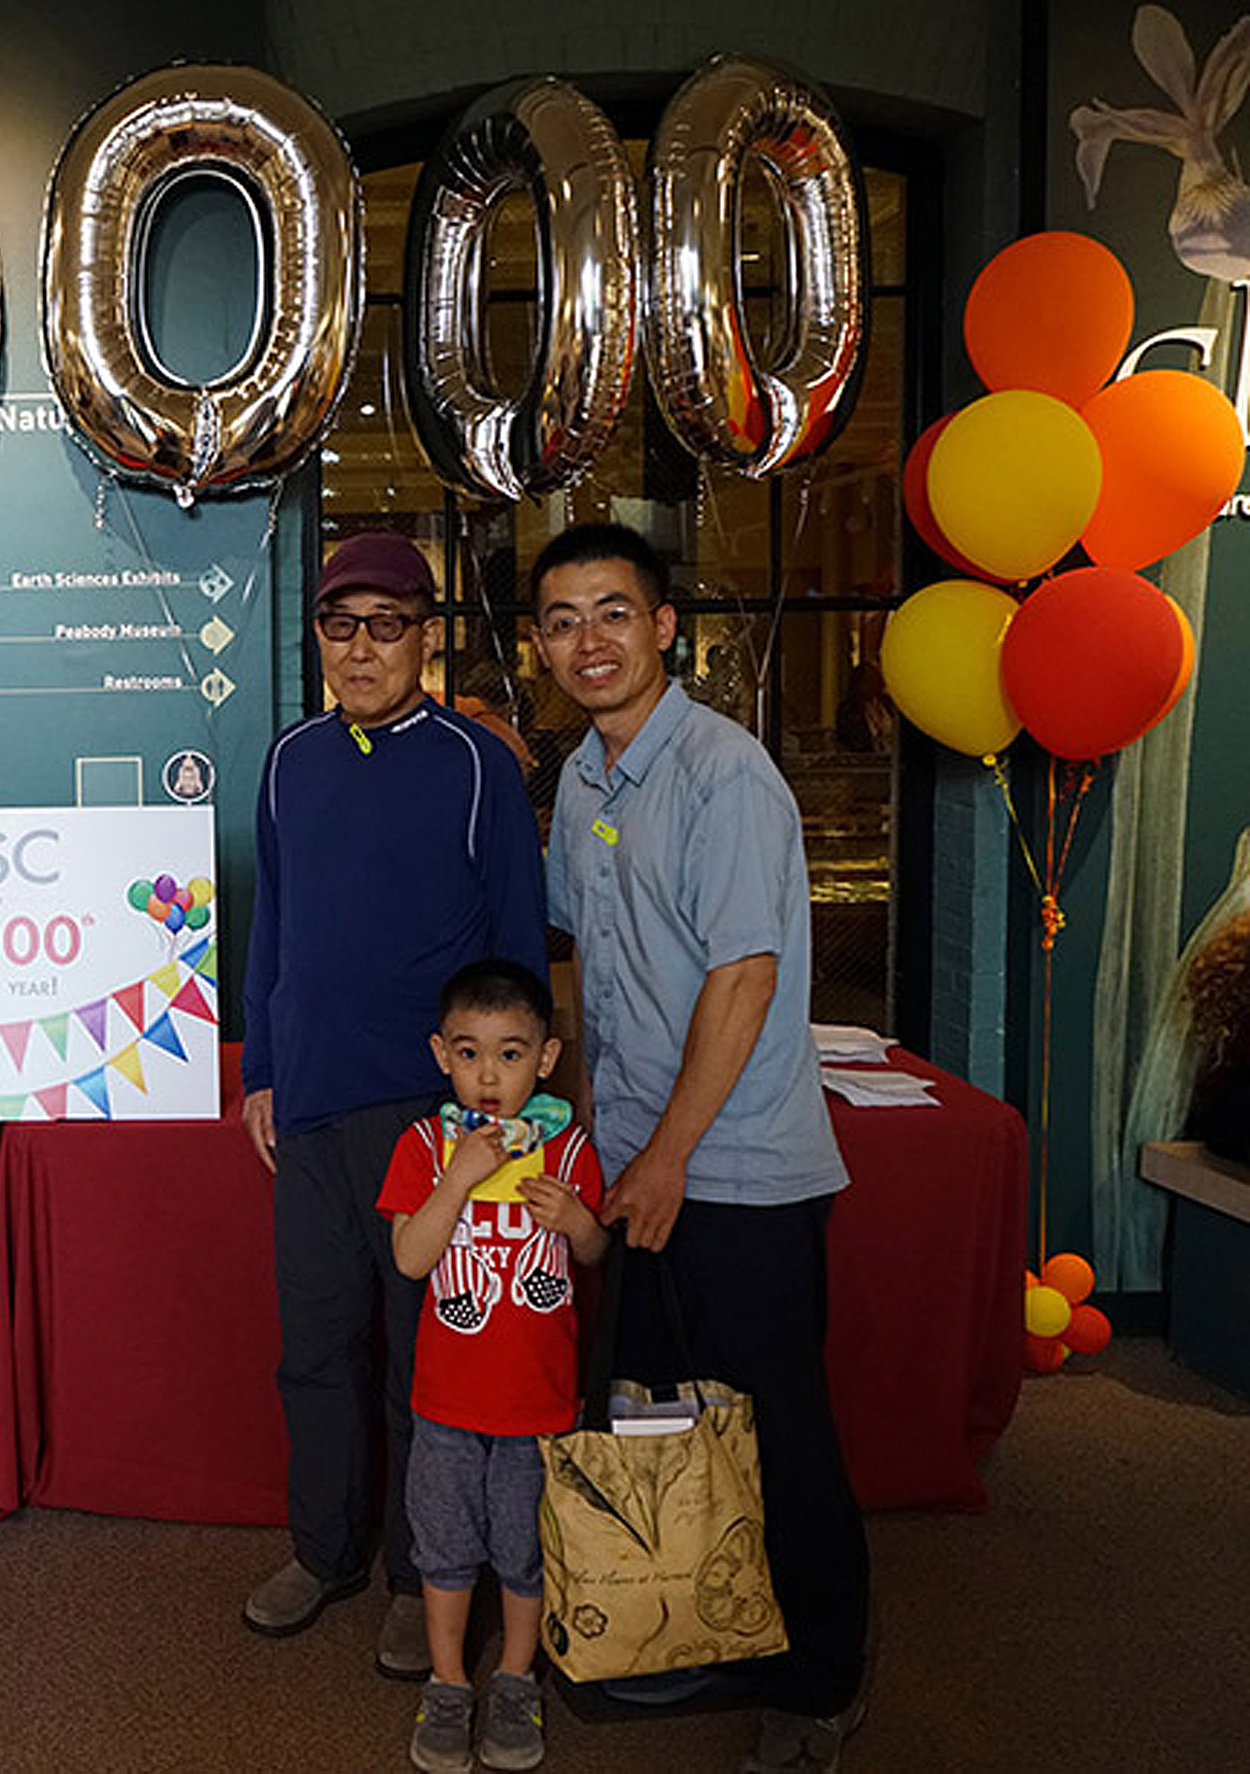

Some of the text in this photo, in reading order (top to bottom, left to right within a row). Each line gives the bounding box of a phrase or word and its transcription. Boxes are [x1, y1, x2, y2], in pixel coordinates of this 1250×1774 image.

[11, 568, 181, 588] Earth Sciences Exhibits
[55, 623, 182, 640] Peabody Museum
[103, 674, 182, 690] Restrooms
[7, 976, 58, 997] YEAR!
